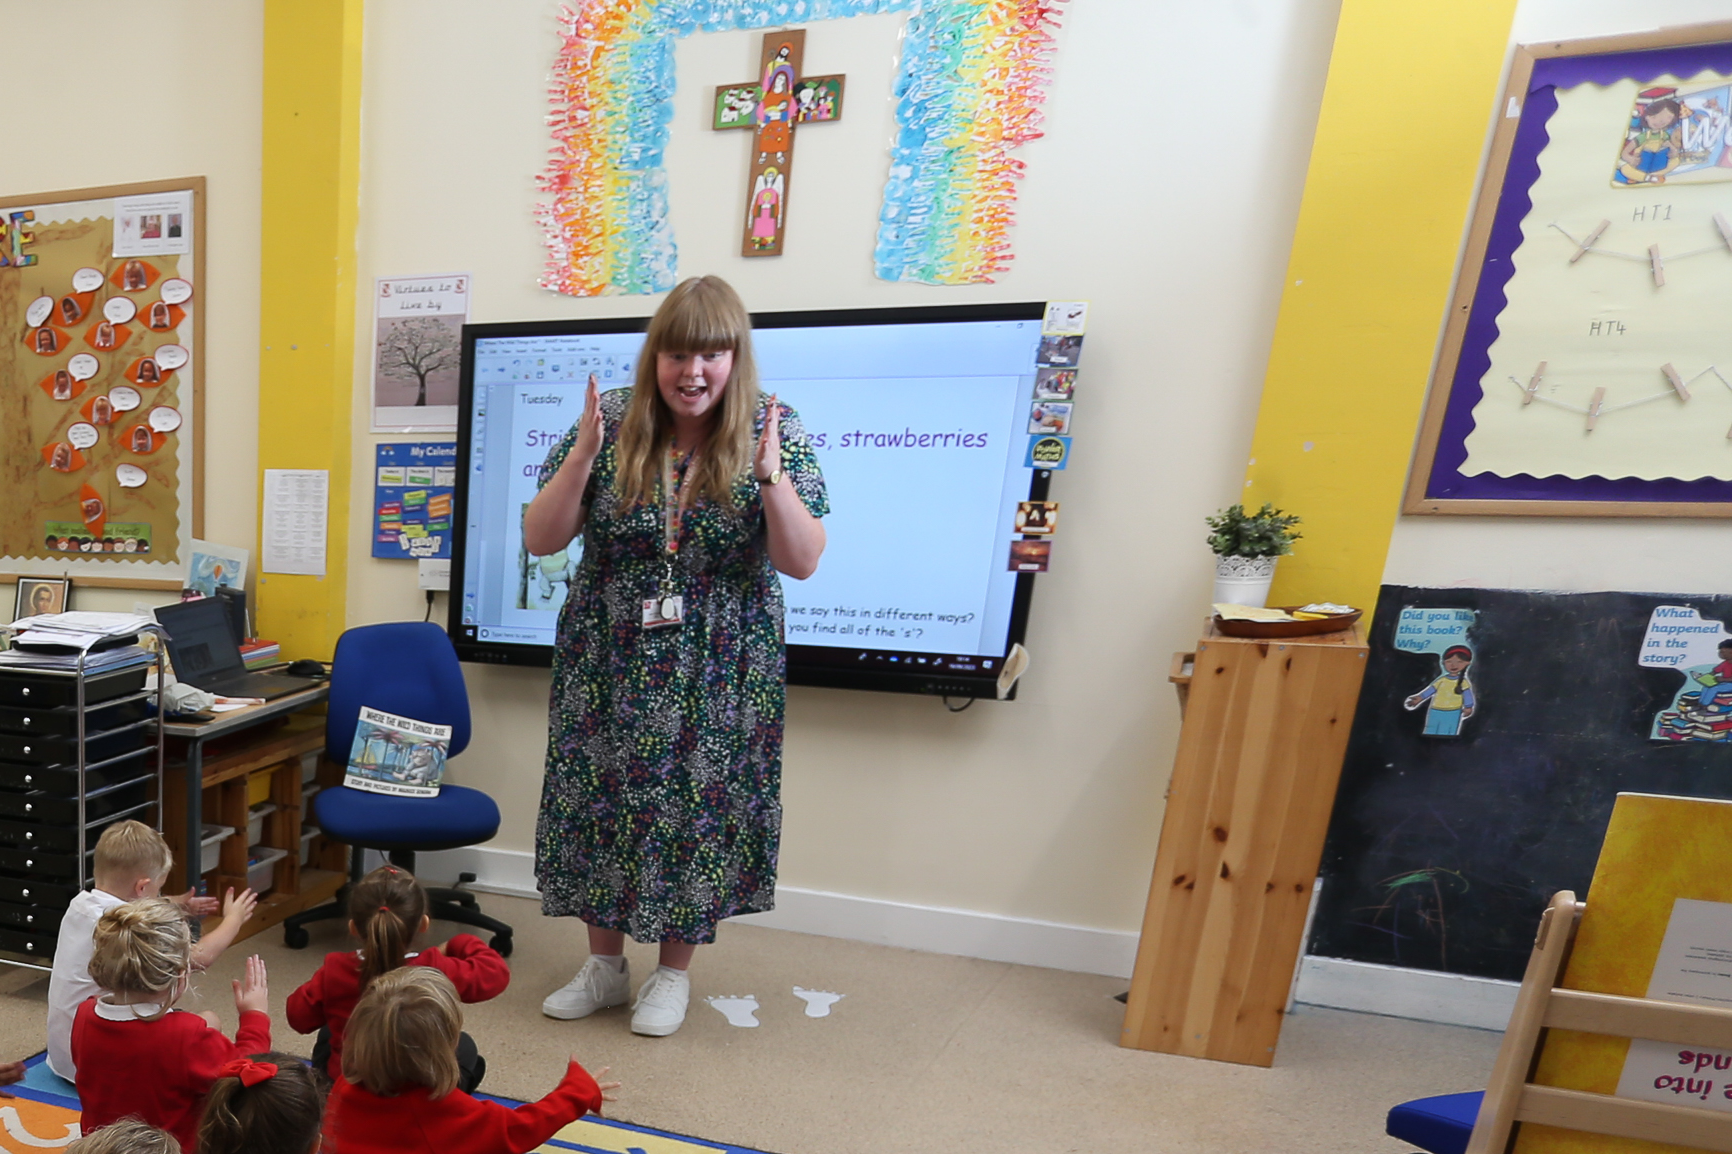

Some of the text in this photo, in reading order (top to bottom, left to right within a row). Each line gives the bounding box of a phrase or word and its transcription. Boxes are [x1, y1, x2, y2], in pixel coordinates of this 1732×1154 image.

[520, 393, 563, 406] Tuesday
[840, 427, 988, 447] strawberries
[410, 446, 425, 458] My
[791, 606, 975, 625] we say this in different ways?
[1402, 611, 1423, 620] Did
[1427, 613, 1450, 623] you
[1656, 608, 1694, 618] What
[788, 624, 809, 635] you
[812, 622, 837, 634] find
[840, 623, 854, 634] all
[857, 624, 872, 635] of
[875, 626, 896, 637] the
[1399, 625, 1463, 634] this book?
[1650, 623, 1721, 635] happened
[1396, 639, 1431, 650] Why?
[1647, 638, 1688, 648] in the
[1643, 654, 1686, 666] story?
[1654, 1075, 1713, 1100] into
